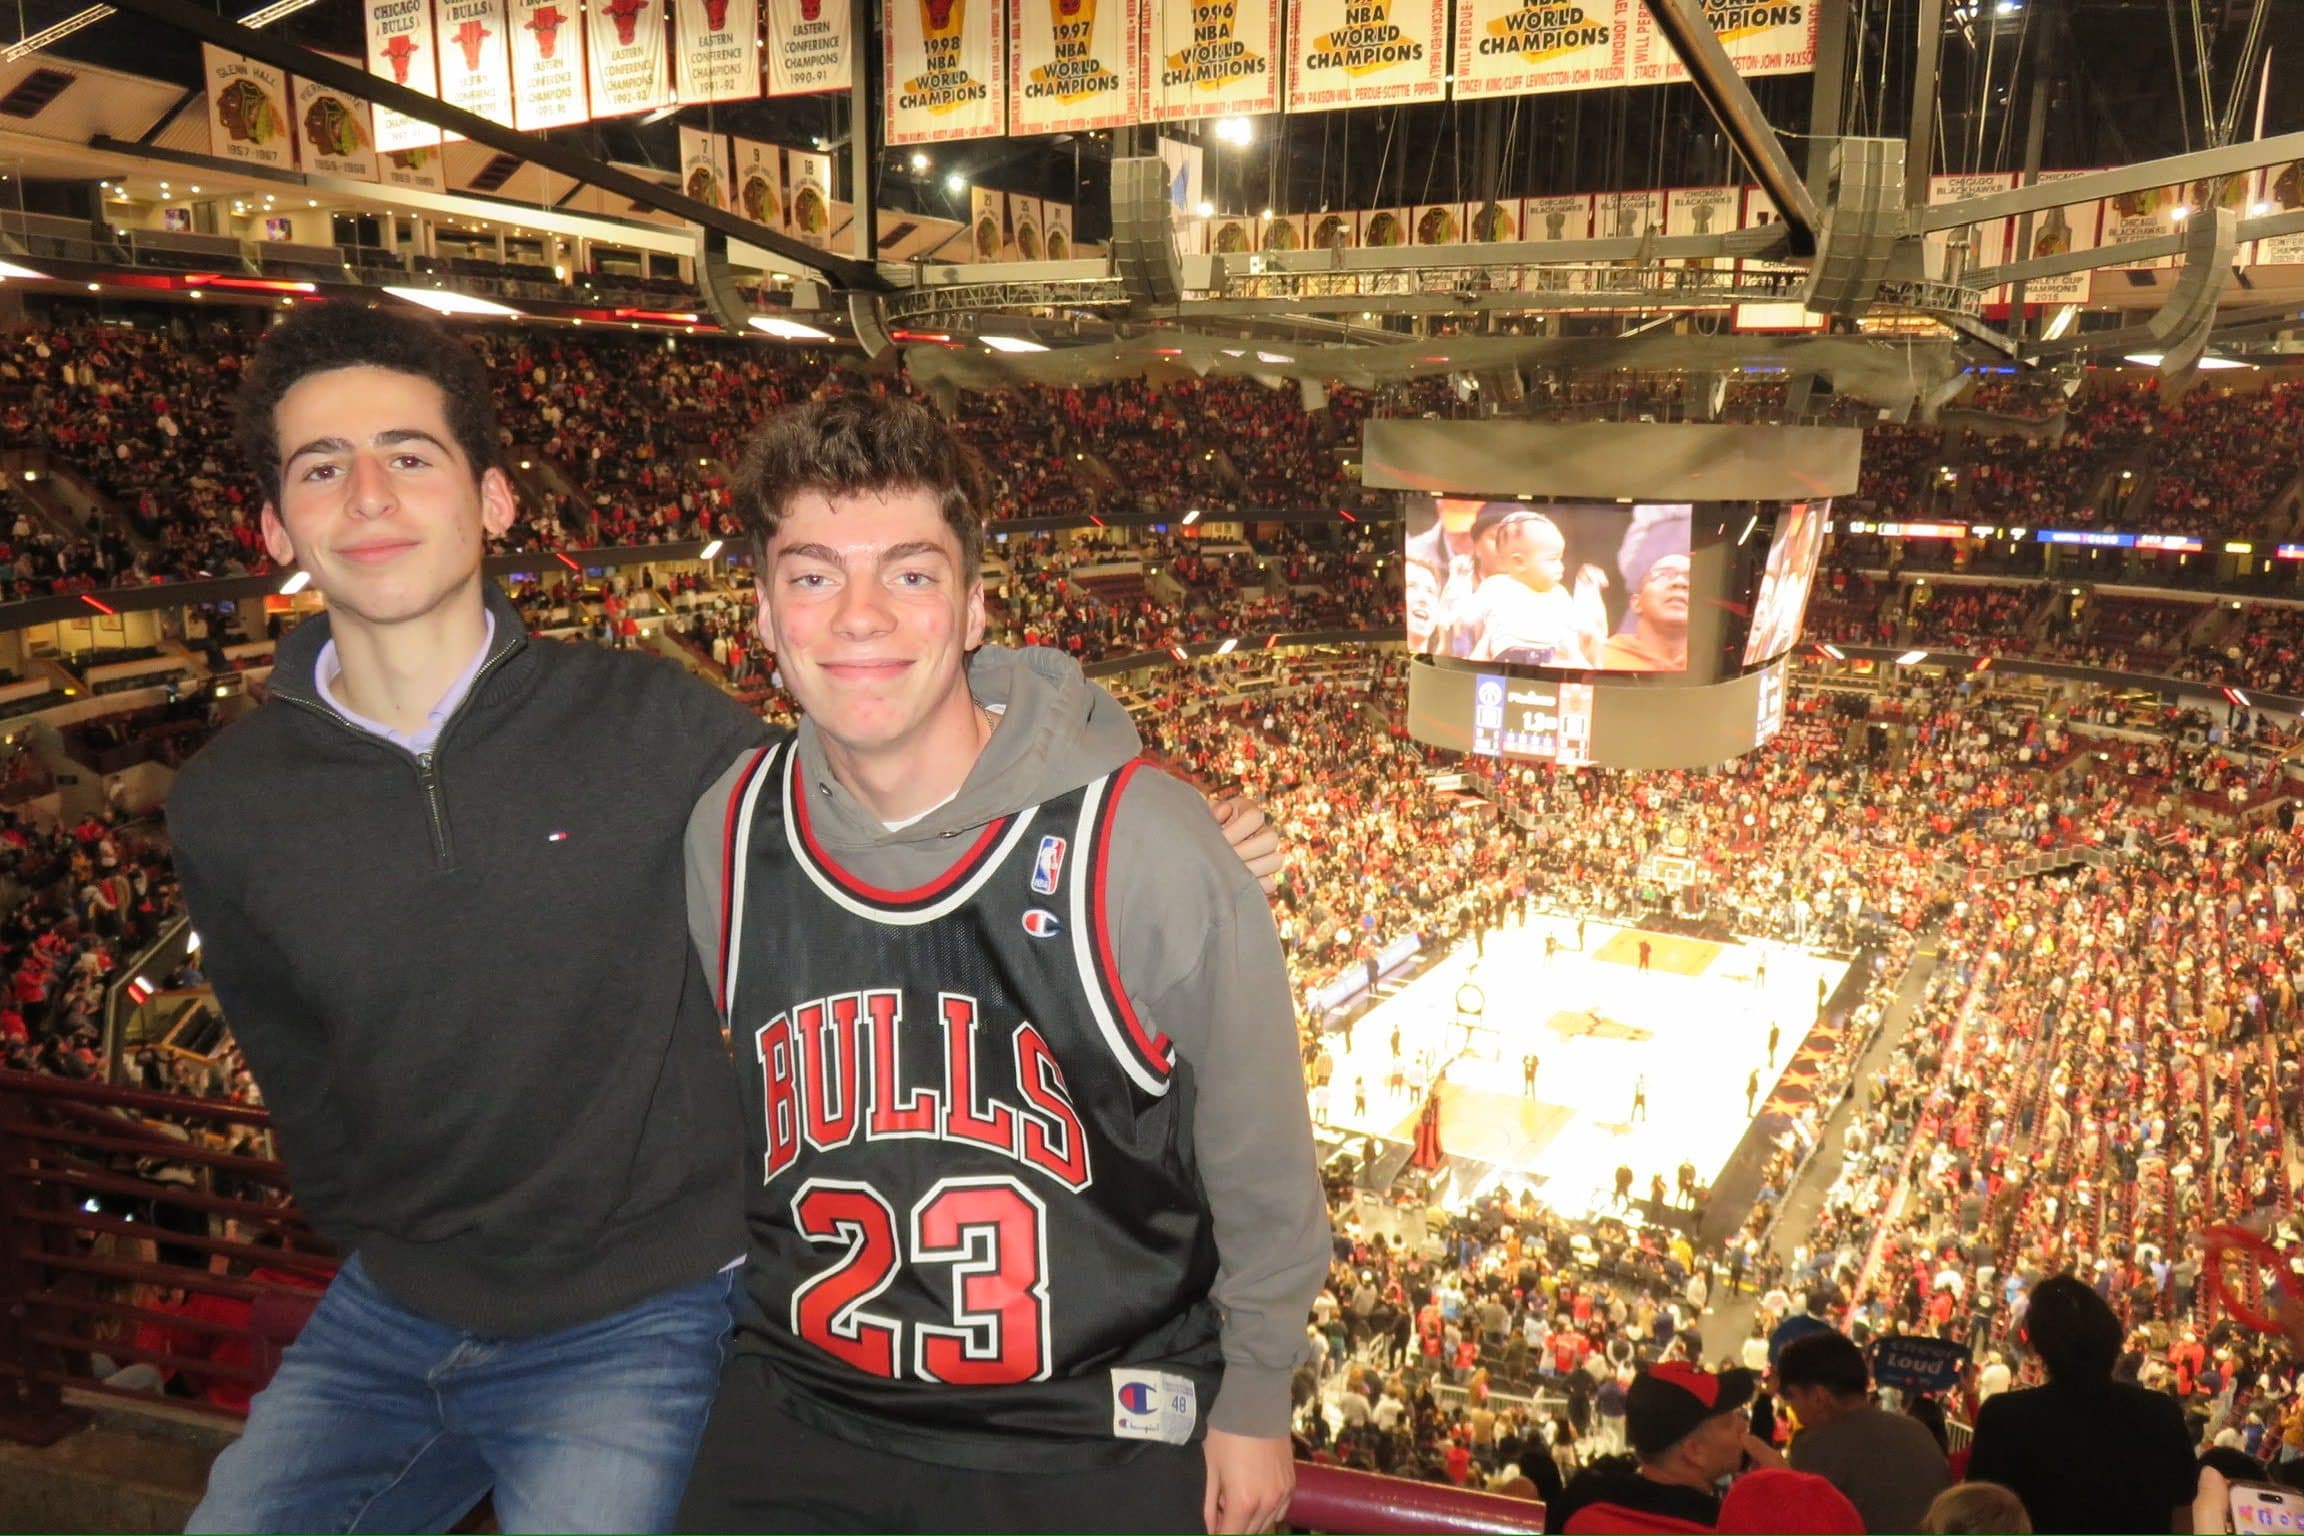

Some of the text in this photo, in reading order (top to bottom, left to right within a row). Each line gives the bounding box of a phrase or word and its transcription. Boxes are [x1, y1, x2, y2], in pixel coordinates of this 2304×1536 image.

[374, 0, 420, 20] CHICAGO
[453, 2, 488, 21] BULLS
[1192, 6, 1234, 23] 1996
[1346, 5, 1384, 24] NBA
[1506, 8, 1584, 31] WORLD
[1708, 5, 1802, 31] MPIONS
[382, 16, 415, 34] BULLS
[793, 22, 830, 36] EASTERN
[1053, 22, 1090, 40] 1997
[1194, 23, 1229, 42] NBA
[699, 33, 734, 48] EASTERN
[785, 36, 839, 53] CONFERENCE
[924, 36, 960, 53] 1998
[1331, 25, 1400, 47] WORLD
[1479, 26, 1610, 55] CHAMPIONS
[1612, 19, 1627, 65] JORDAN
[691, 47, 742, 64] CONFERENCE
[1055, 42, 1087, 58] NBA
[1181, 41, 1244, 64] WORLD
[1307, 43, 1423, 70] CHAMPIONS
[1634, 36, 1649, 63] WILL
[785, 53, 838, 69] CHAMPIONS
[927, 56, 956, 70] NBA
[1044, 59, 1099, 78] WORLD
[1429, 52, 1441, 79] NEALY
[1459, 51, 1471, 77] WILL
[692, 63, 741, 79] CHAMPIONS
[790, 71, 827, 84] 1990-91
[916, 71, 968, 89] WORLD
[1162, 57, 1266, 87] CHAMPIONS
[1457, 79, 1482, 94] STACEY
[1594, 66, 1624, 81] PAXSON
[1634, 63, 1684, 79] STACEY KING
[1025, 76, 1118, 98] CHAMPIONS
[1414, 81, 1440, 95] PIPPEN
[900, 85, 986, 109] CHAMPIONS
[1936, 185, 2004, 195] BLACKHAWKS
[1949, 177, 1995, 186] CHICAGO
[2026, 284, 2078, 294] HAMPIONS
[755, 988, 1093, 1195] BULLS
[789, 1175, 1052, 1386] 23
[1171, 1395, 1187, 1414] 48
